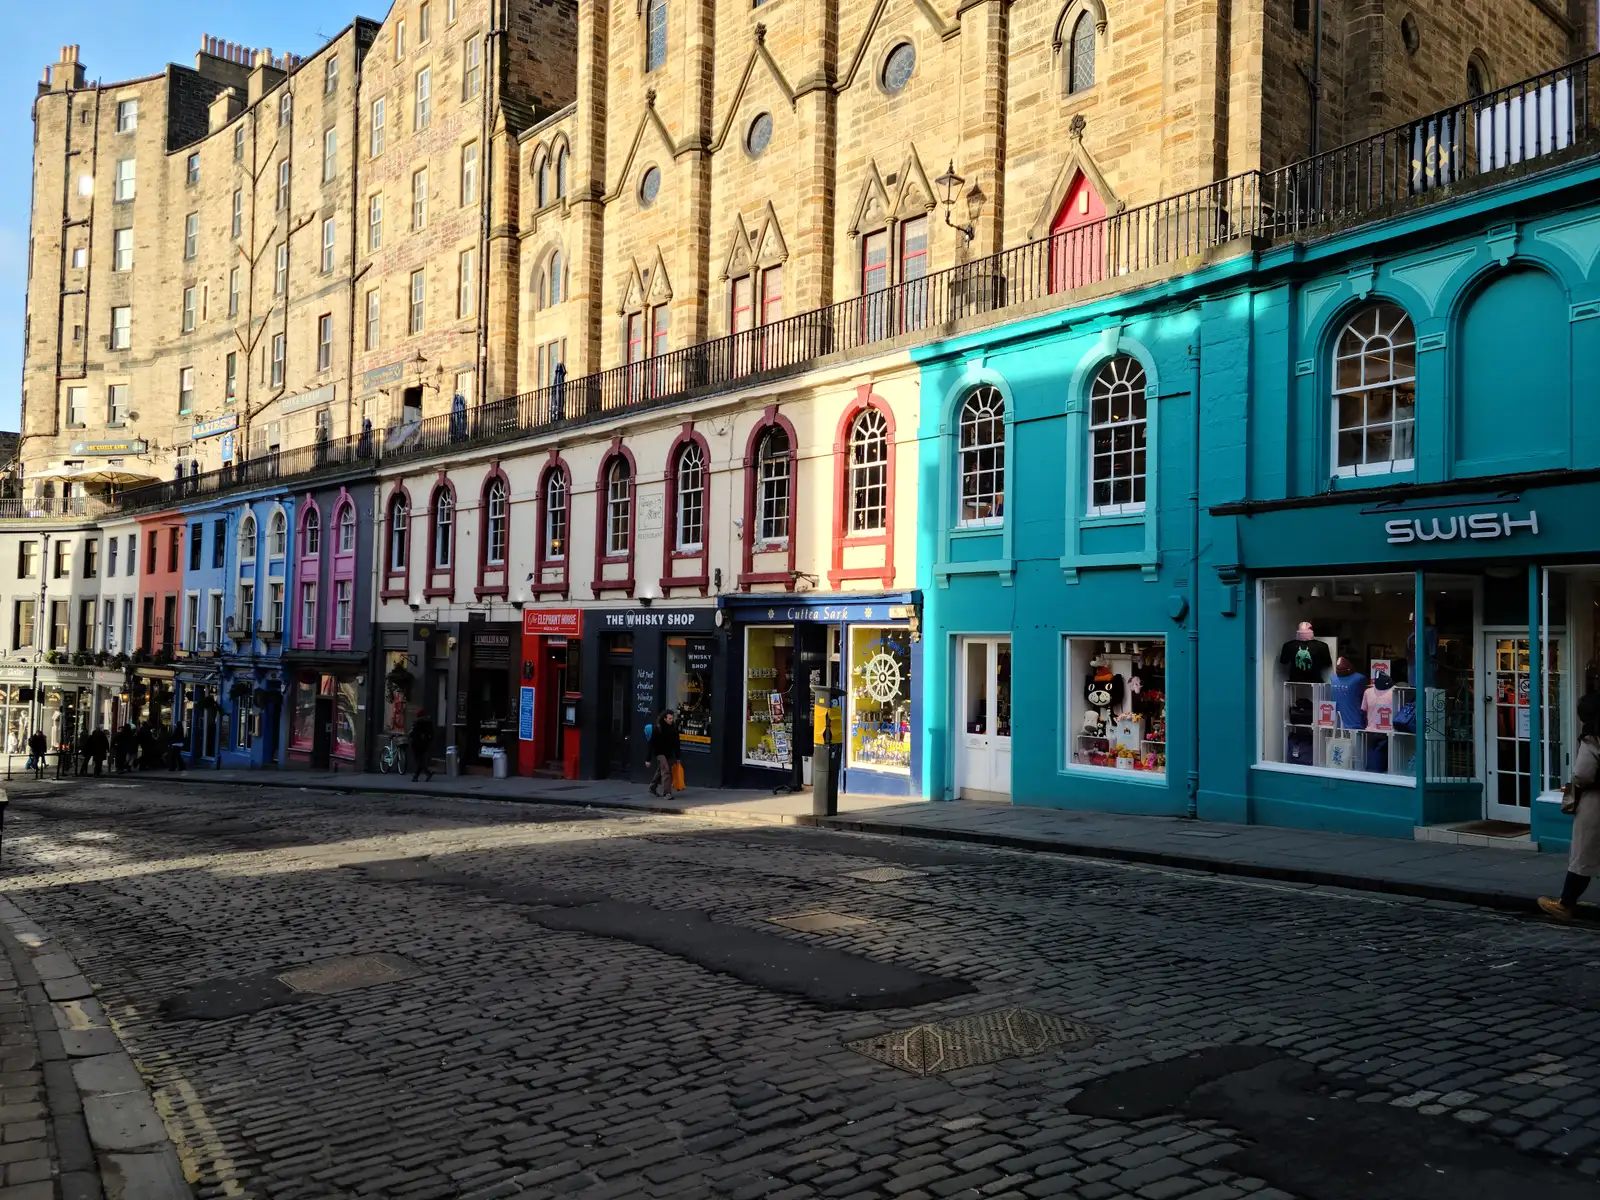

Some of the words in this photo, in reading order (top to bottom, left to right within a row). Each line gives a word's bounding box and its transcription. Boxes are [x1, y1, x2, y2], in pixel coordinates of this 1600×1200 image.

[1385, 510, 1539, 543] SWISH
[537, 614, 561, 625] ELEPHANT
[561, 614, 577, 625] HOUSE
[823, 606, 848, 620] Sark
[606, 614, 624, 625] THE
[626, 614, 664, 626] WHISKY
[667, 614, 695, 625] SHOP
